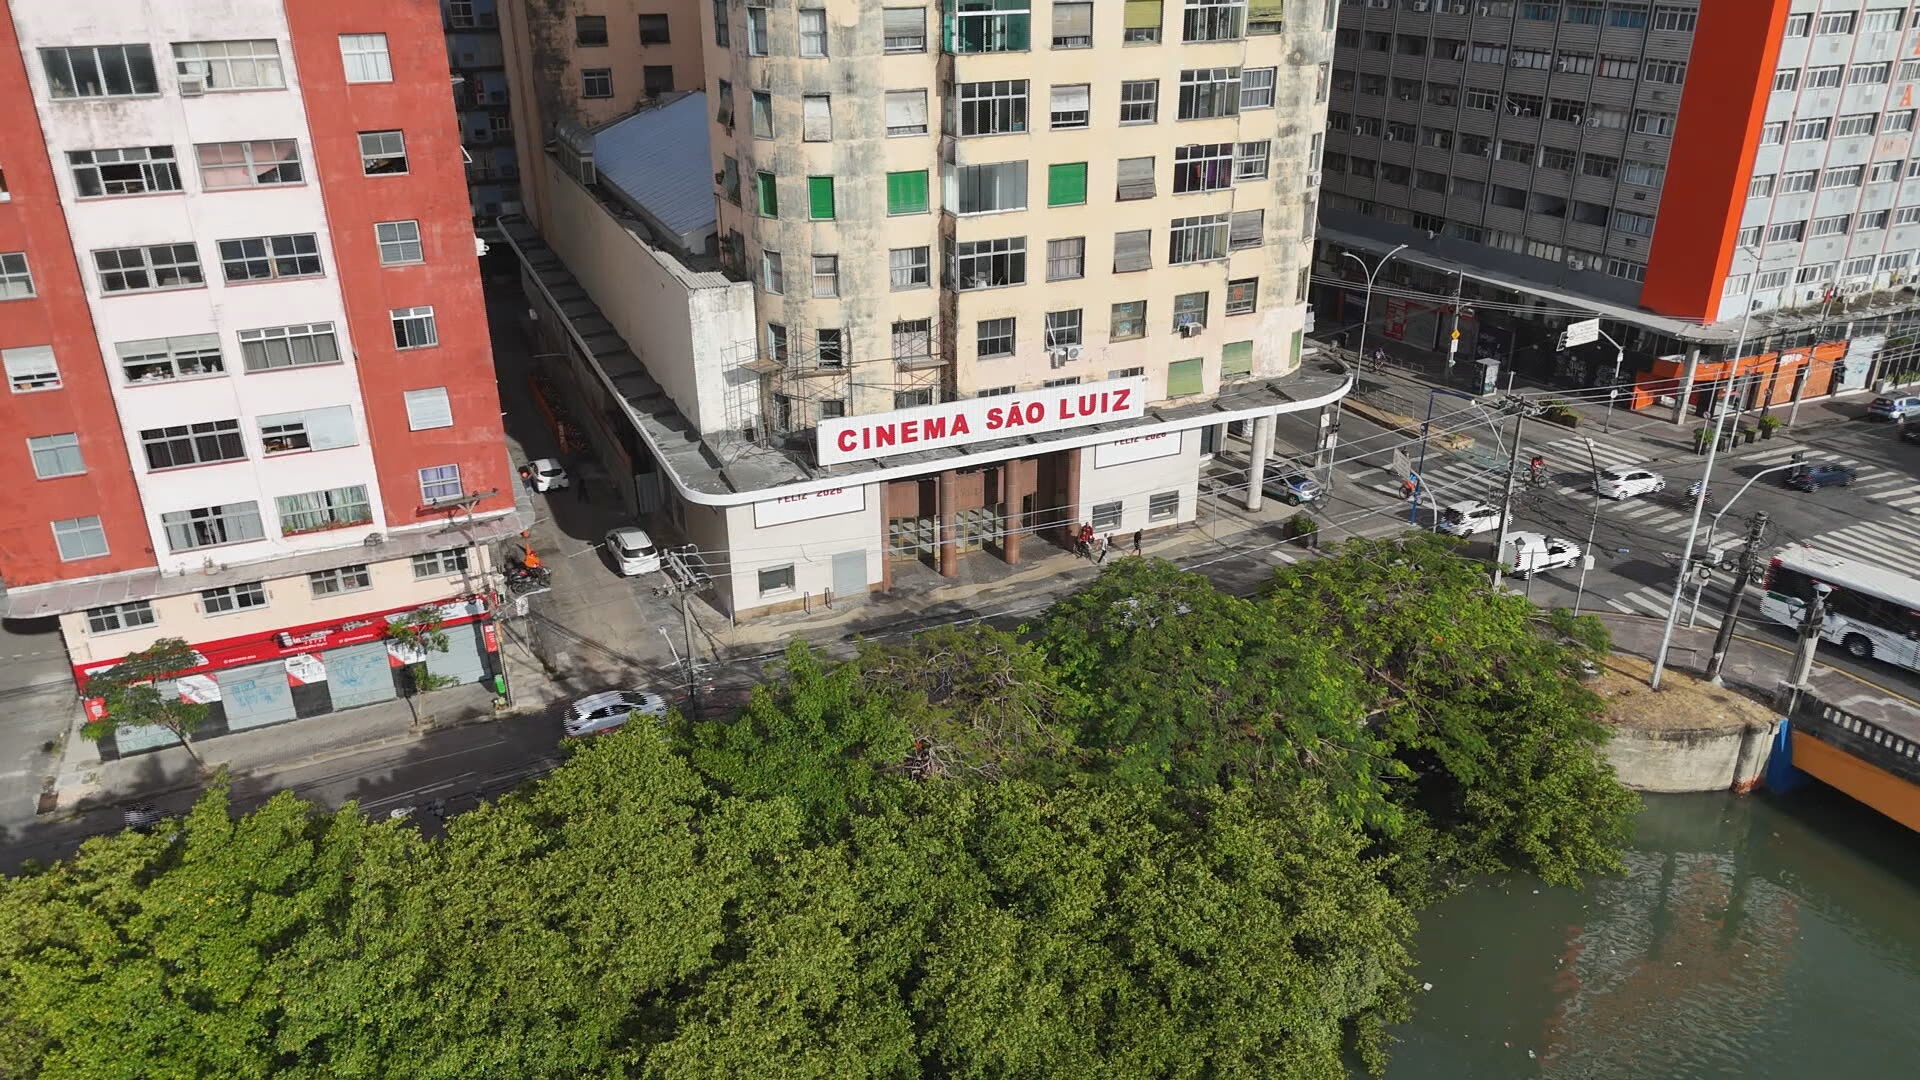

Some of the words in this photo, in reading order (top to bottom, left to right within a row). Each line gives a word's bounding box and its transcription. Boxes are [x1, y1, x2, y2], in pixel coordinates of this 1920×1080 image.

[838, 413, 970, 451] CINEMA
[987, 401, 1045, 430] SÃO
[1060, 389, 1131, 419] LUIZ
